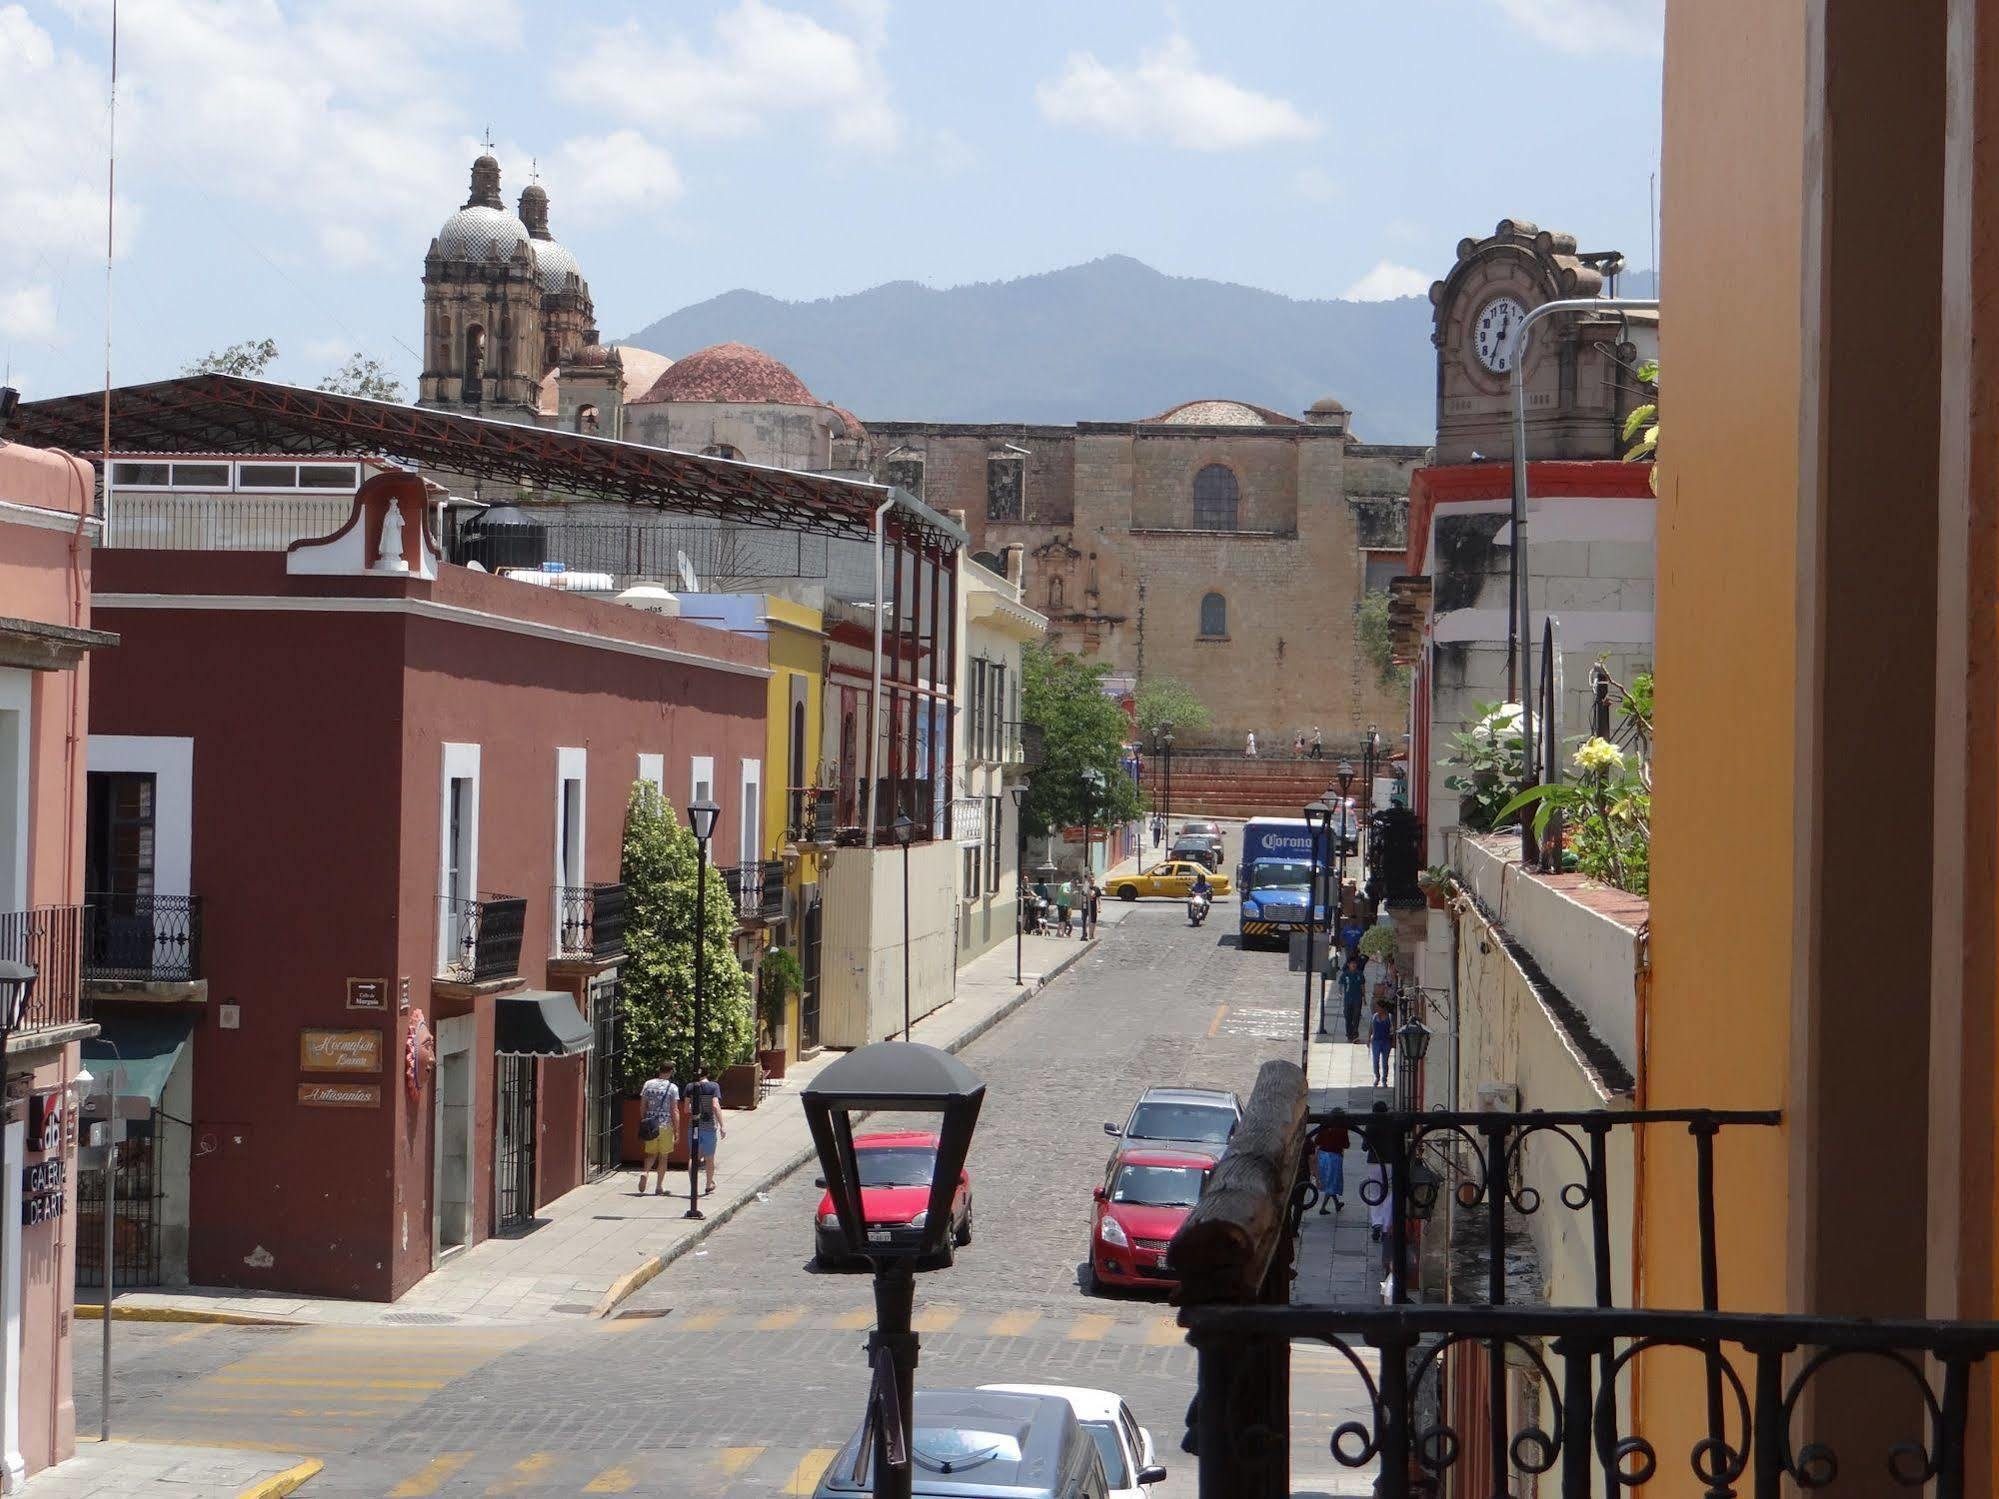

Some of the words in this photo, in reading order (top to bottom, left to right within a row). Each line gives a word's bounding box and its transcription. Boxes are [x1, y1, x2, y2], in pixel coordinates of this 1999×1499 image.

[1490, 307, 1497, 319] 11
[1500, 303, 1508, 314] 12
[1483, 319, 1491, 329] 10
[1480, 332, 1486, 342] 9
[1482, 345, 1488, 356] 8
[1499, 359, 1505, 369] 6
[31, 1198, 42, 1225] DE
